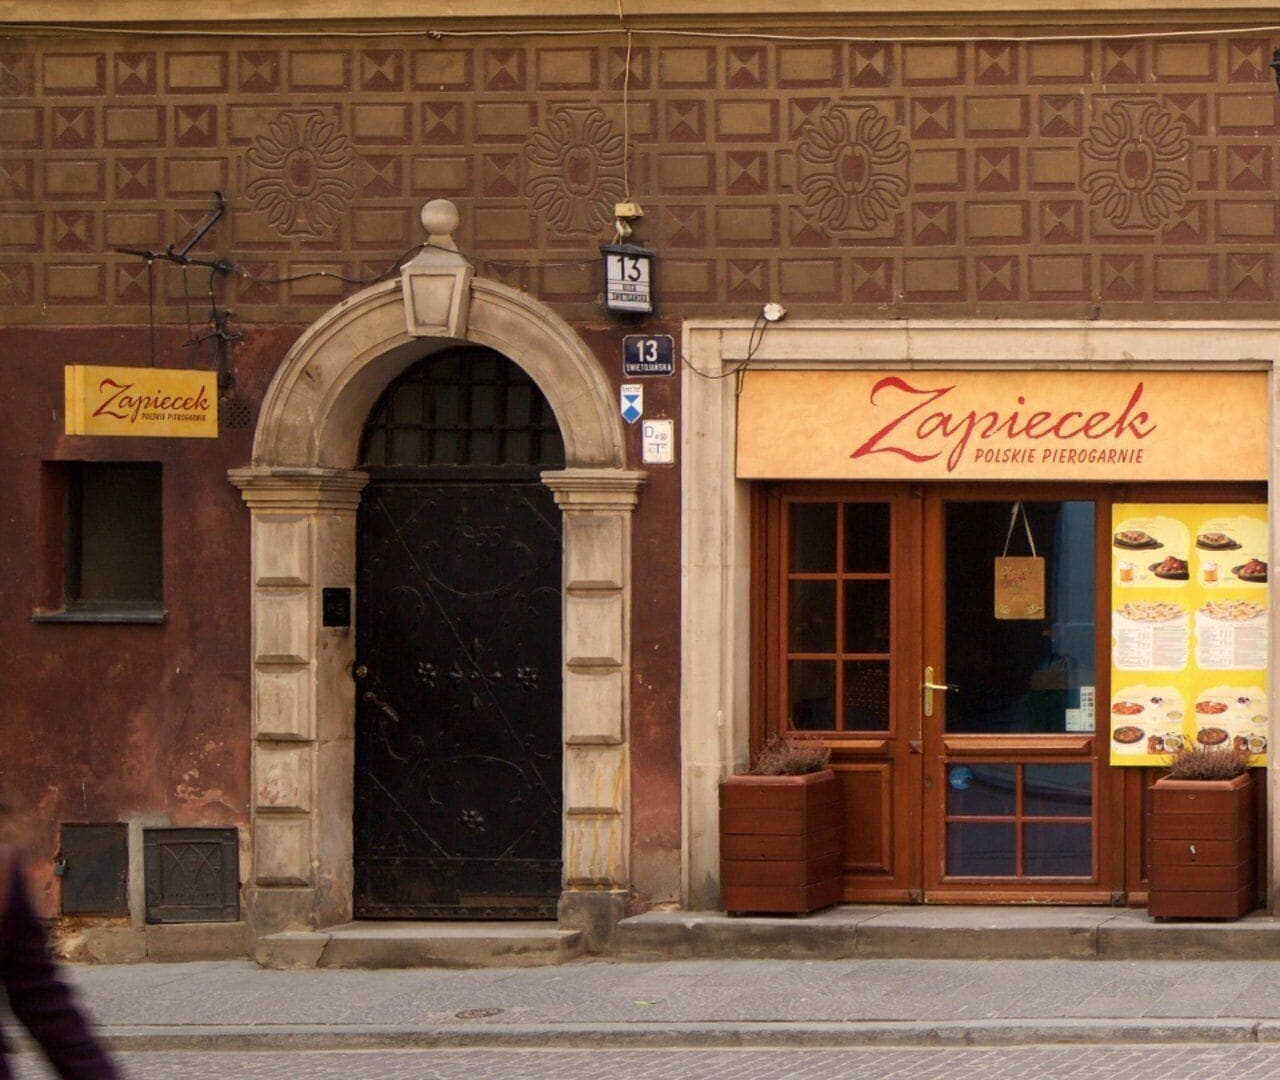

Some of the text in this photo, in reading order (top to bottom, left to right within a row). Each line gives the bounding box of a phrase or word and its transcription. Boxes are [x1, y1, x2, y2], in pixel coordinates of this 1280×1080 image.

[616, 255, 642, 282] 13
[636, 339, 658, 362] 13
[92, 378, 211, 424] Zapiecek
[849, 376, 1157, 473] Zapiecek
[974, 448, 1144, 464] POLSKIE PIEROGARNIE
